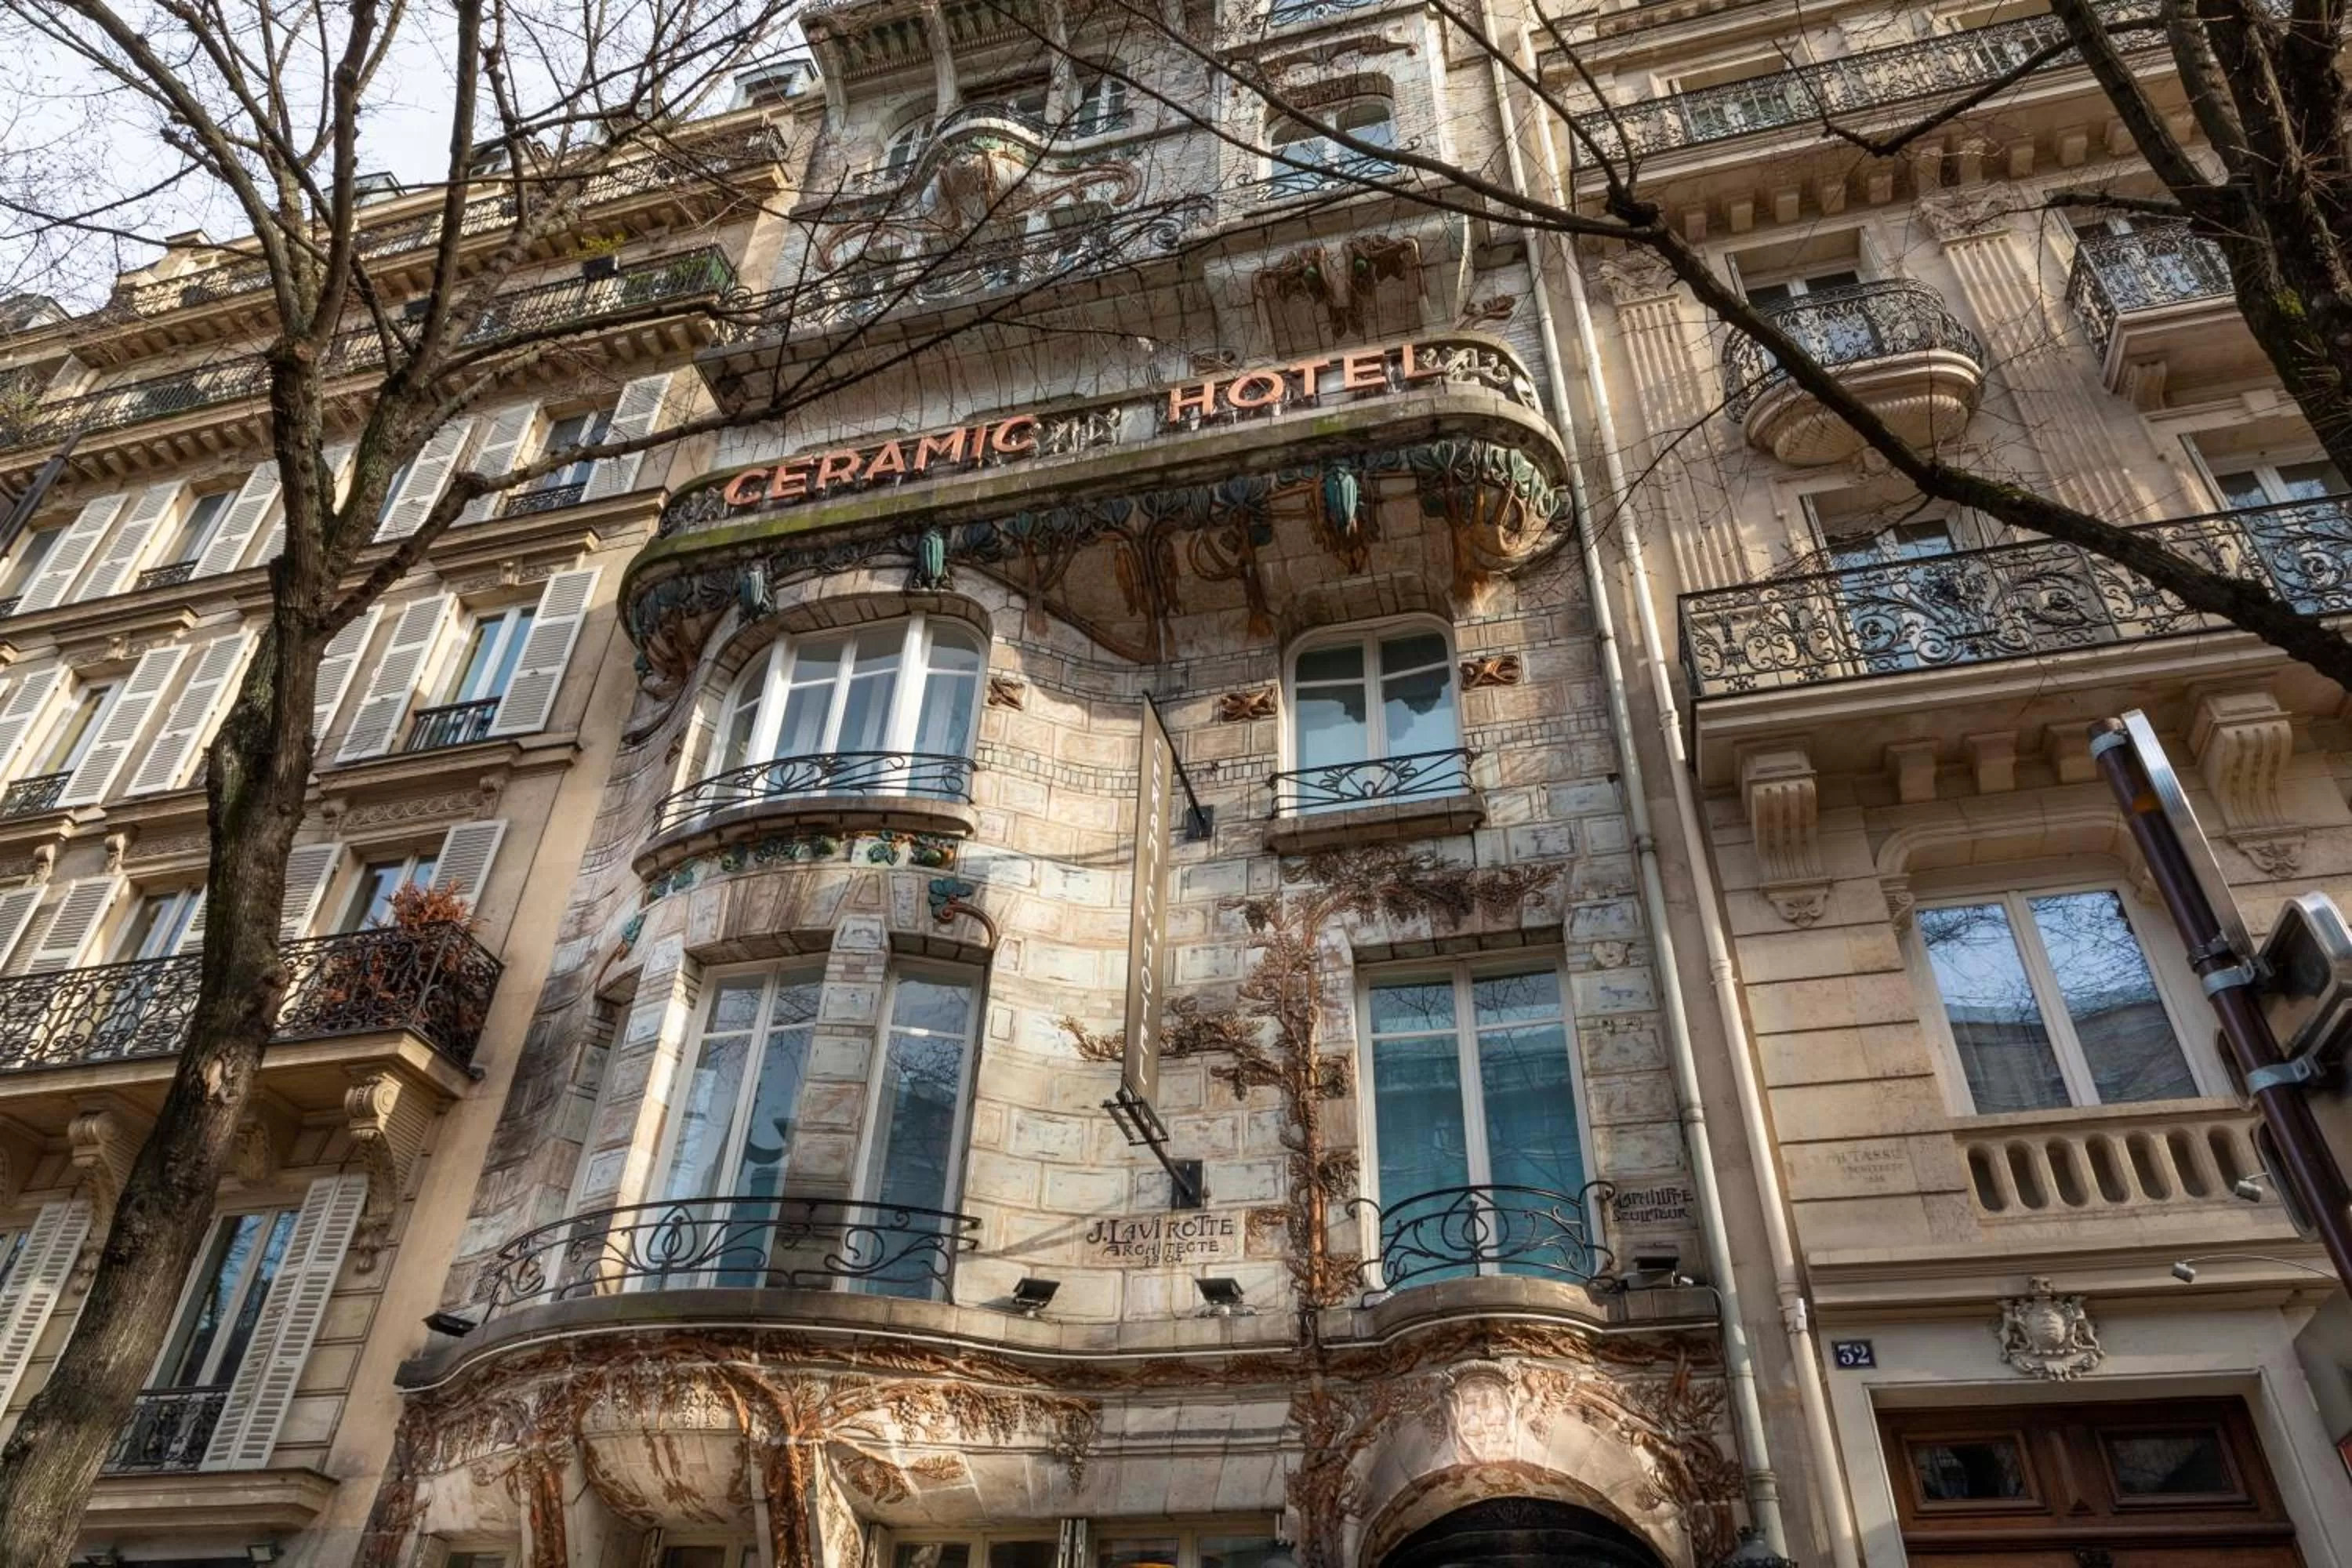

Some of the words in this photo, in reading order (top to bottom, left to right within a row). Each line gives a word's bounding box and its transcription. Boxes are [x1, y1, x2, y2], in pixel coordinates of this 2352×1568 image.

[724, 414, 1040, 506] CERAMIC
[1168, 343, 1446, 424] HOTEL
[1146, 738, 1162, 914] CERAMIC
[1139, 936, 1153, 1086] HOTEL
[1103, 1240, 1220, 1258] ARCHITECTE
[1838, 1344, 1870, 1365] 32
